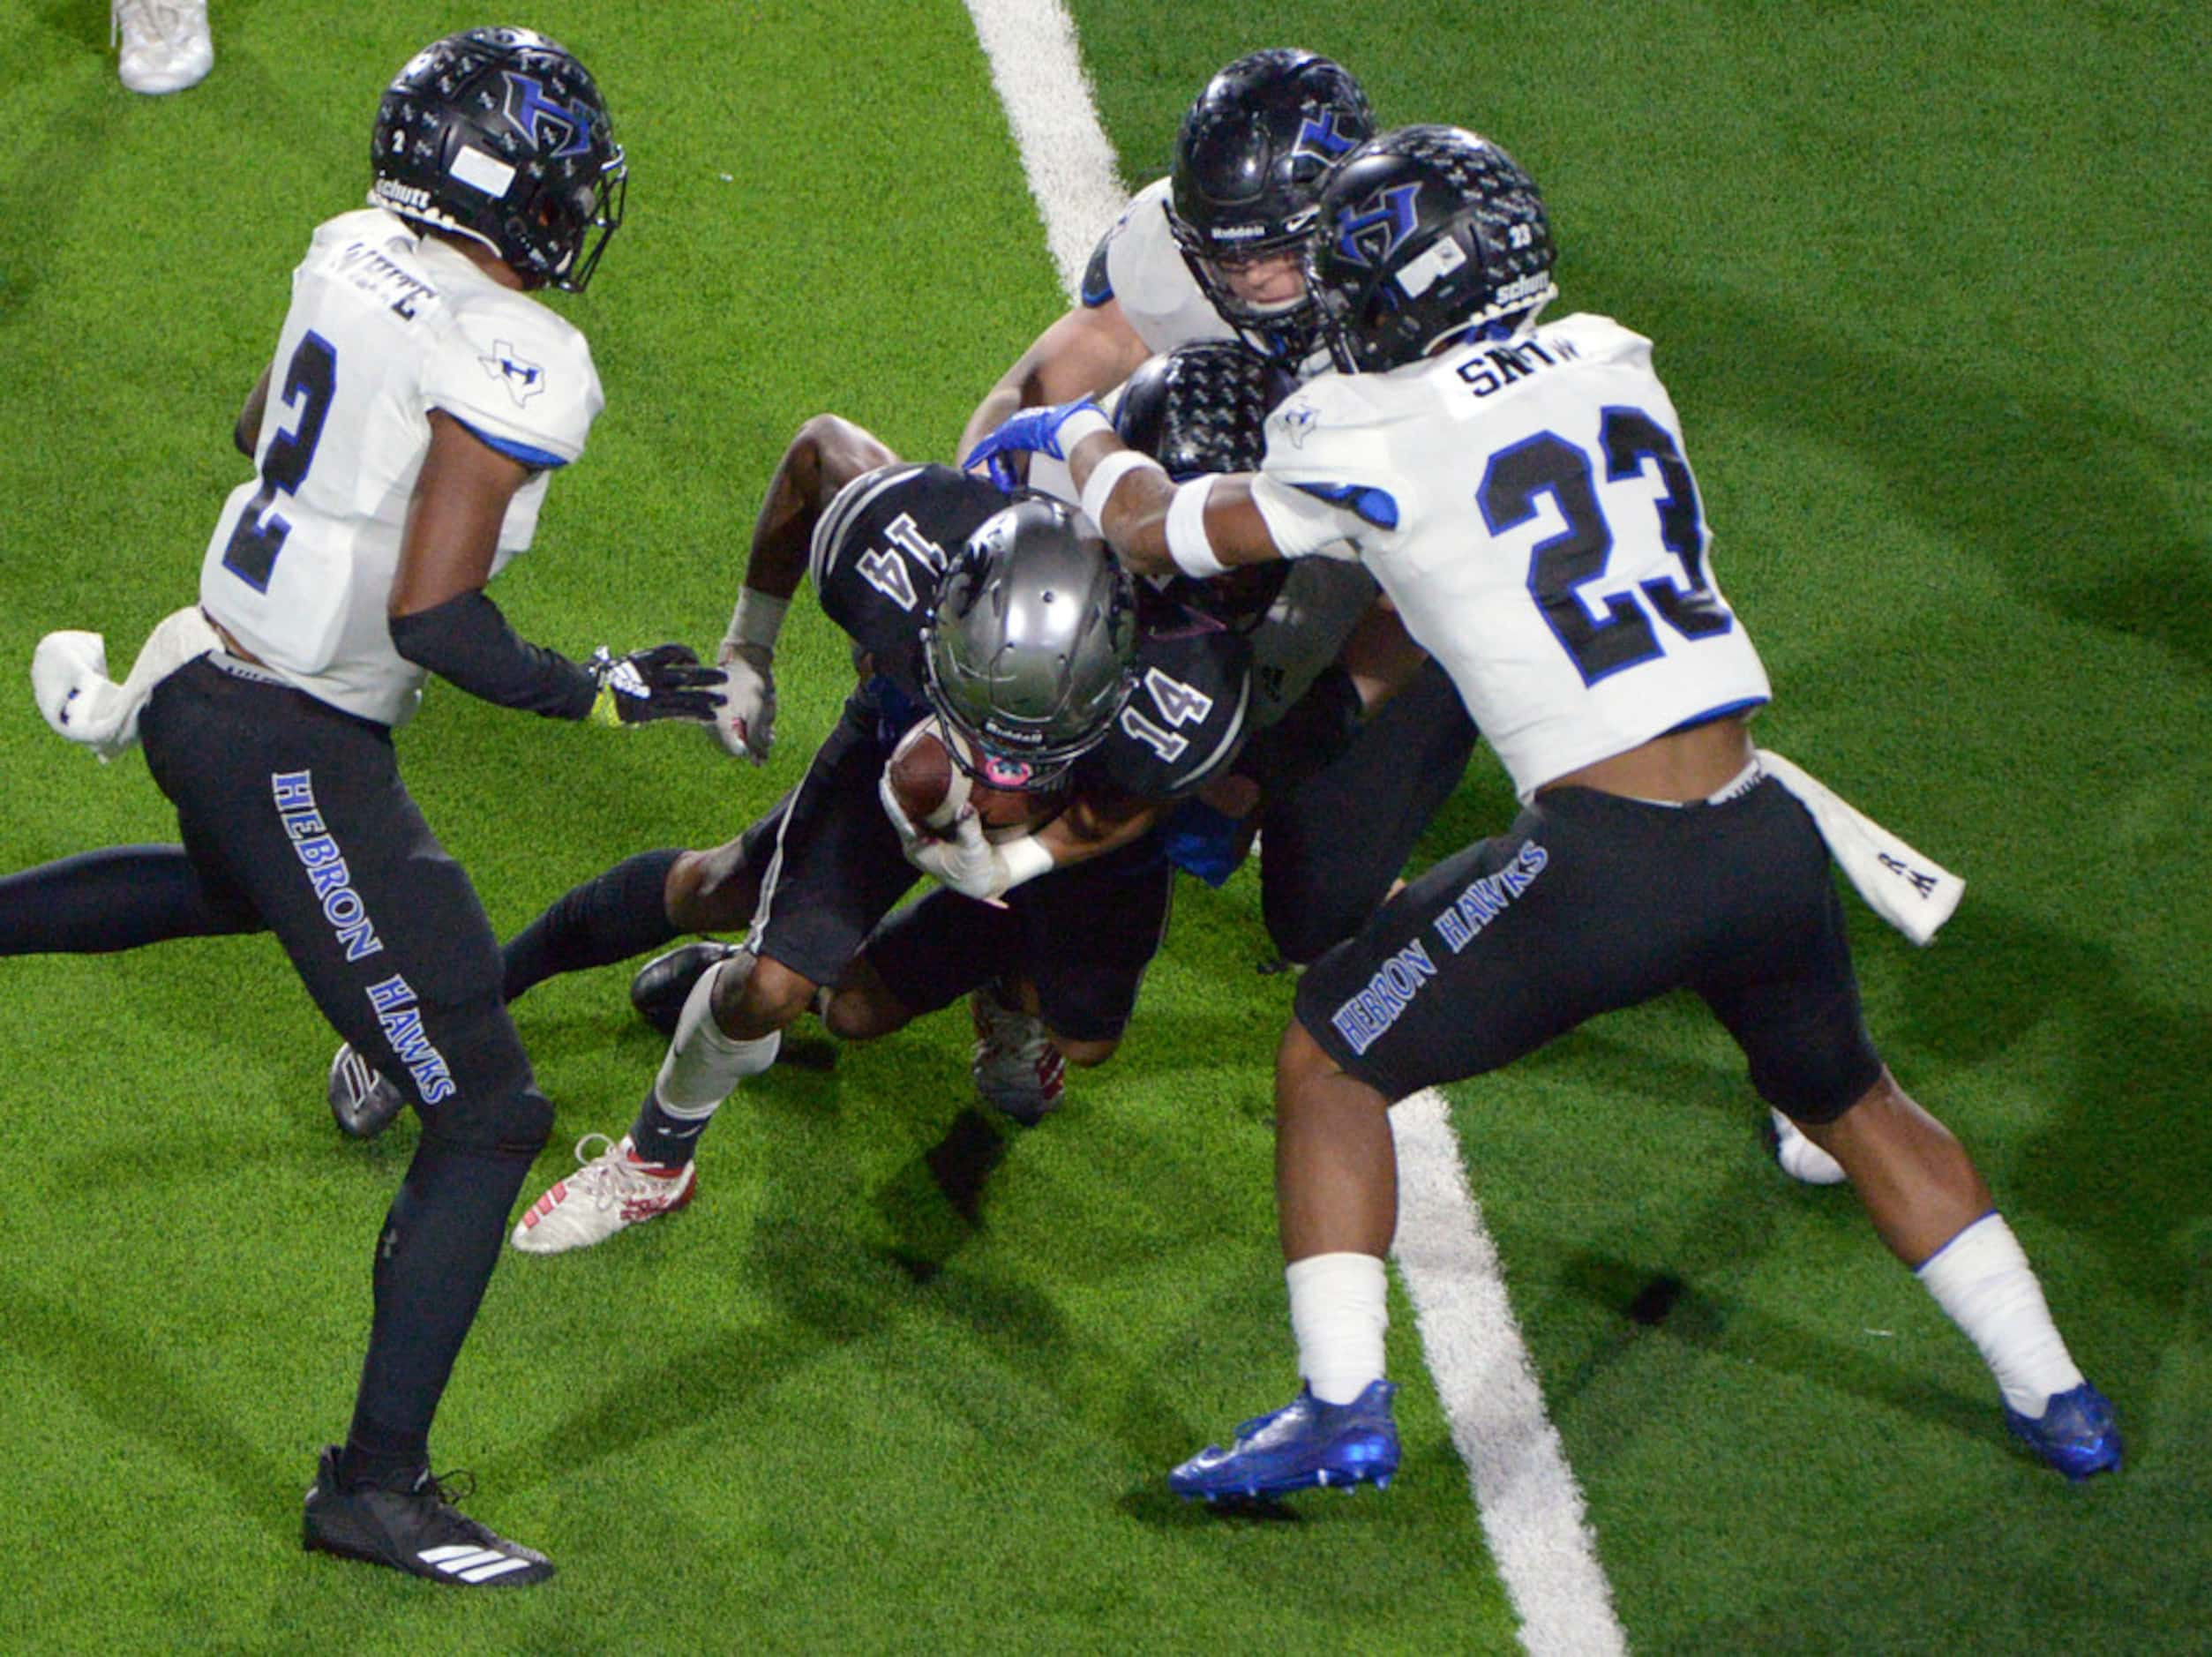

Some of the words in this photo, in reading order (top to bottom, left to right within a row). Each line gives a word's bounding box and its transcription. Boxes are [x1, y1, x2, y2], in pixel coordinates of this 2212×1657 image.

[392, 129, 406, 154] 2
[1509, 223, 1533, 250] 23
[221, 328, 338, 595] 2
[853, 511, 949, 613] 14
[1475, 404, 1734, 690] 23
[1120, 667, 1214, 763] 14
[271, 769, 385, 963] HEBRON
[365, 972, 457, 1106] HAWKS
[1331, 938, 1438, 1056] HEBRON
[1433, 839, 1549, 955] HAWKS
